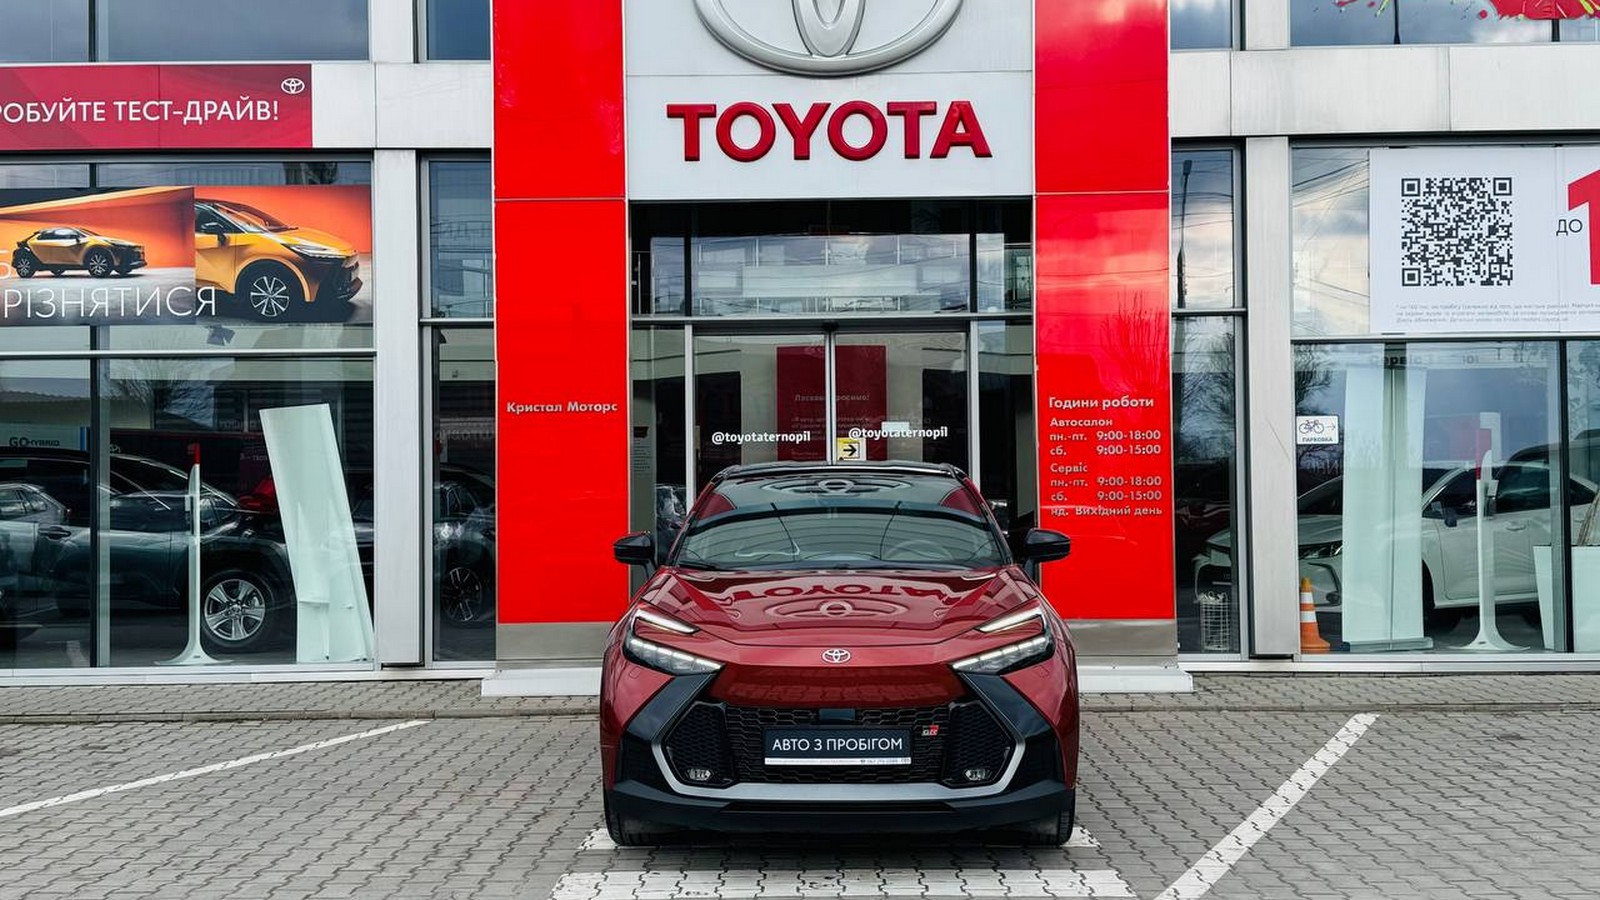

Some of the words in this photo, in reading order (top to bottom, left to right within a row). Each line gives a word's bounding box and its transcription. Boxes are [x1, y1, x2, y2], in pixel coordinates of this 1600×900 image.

[0, 97, 106, 122] ОБУЙТЕ
[113, 95, 279, 125] ТЕСТ-ДРАЙВ!
[666, 100, 993, 163] TOYOTA
[1556, 218, 1583, 236] ДО
[4, 286, 216, 318] РІЗНЯТИСЯ
[507, 402, 562, 415] Кристал
[567, 401, 618, 414] Моторс
[1048, 397, 1098, 410] Години
[1102, 395, 1155, 410] роботи
[1050, 417, 1113, 427] Автосалон
[711, 431, 811, 446] @toyotaternopil
[848, 426, 948, 441] @toyotaternopil
[1050, 433, 1088, 441] пн.-пт.
[1096, 430, 1161, 441] 9:00-18:00
[1050, 446, 1067, 455] сб.
[1096, 444, 1161, 455] 9:00-15:00
[1050, 462, 1088, 475] Сервіс
[1097, 476, 1162, 486] 9:00-18:00
[1051, 491, 1068, 501] сб.
[1097, 491, 1162, 501] 9:00-15:00
[1075, 505, 1131, 516] Вихідний
[1134, 507, 1163, 516] день
[772, 739, 810, 751] АВТО
[827, 738, 903, 750] ПРОБІГОМ
